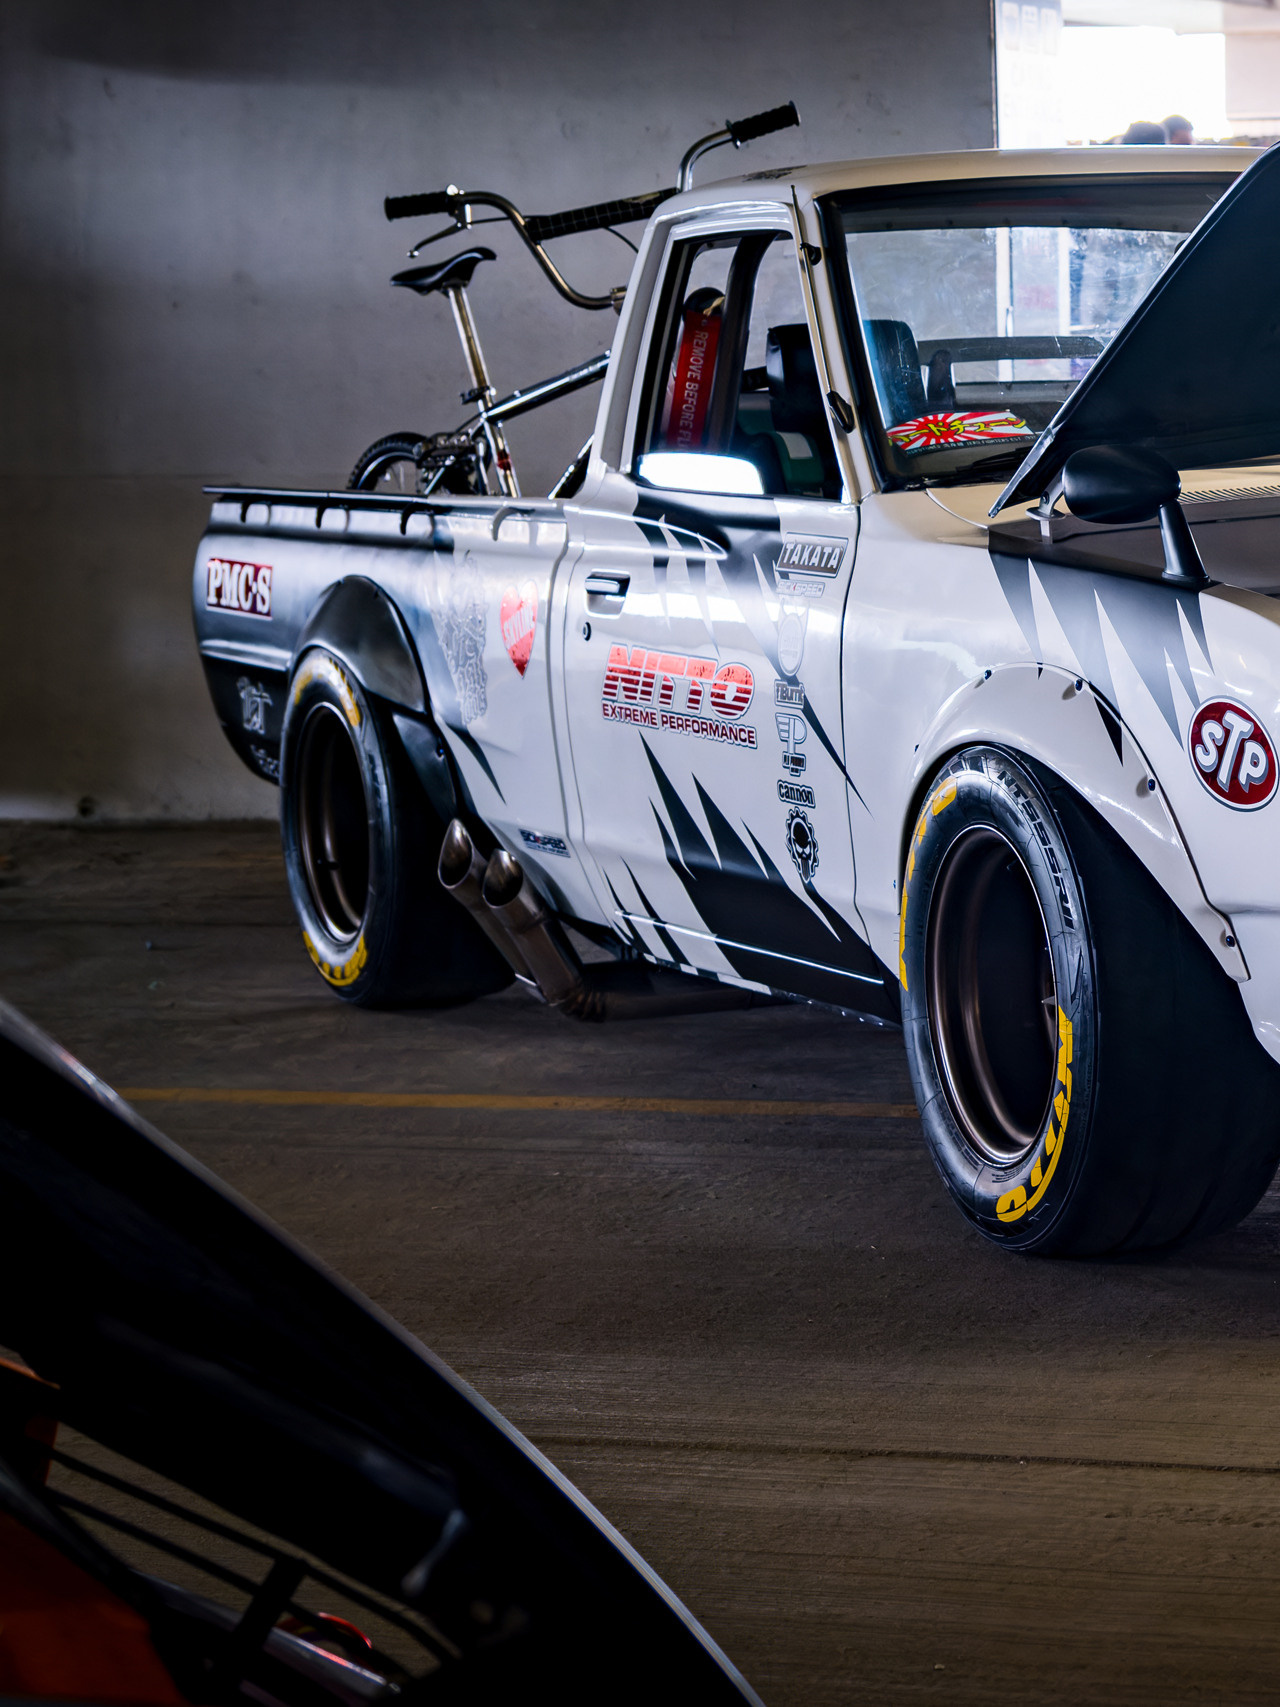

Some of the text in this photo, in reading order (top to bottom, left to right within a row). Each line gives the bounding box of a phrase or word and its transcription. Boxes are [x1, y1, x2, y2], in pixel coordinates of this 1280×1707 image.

[687, 330, 709, 380] REMOVE
[679, 381, 700, 431] BEFORE
[783, 542, 843, 569] TAKATA
[602, 643, 754, 720] NITTO
[602, 703, 756, 745] EXTREME PERFORMANCE
[1194, 709, 1270, 793] STP
[778, 784, 814, 805] cannon
